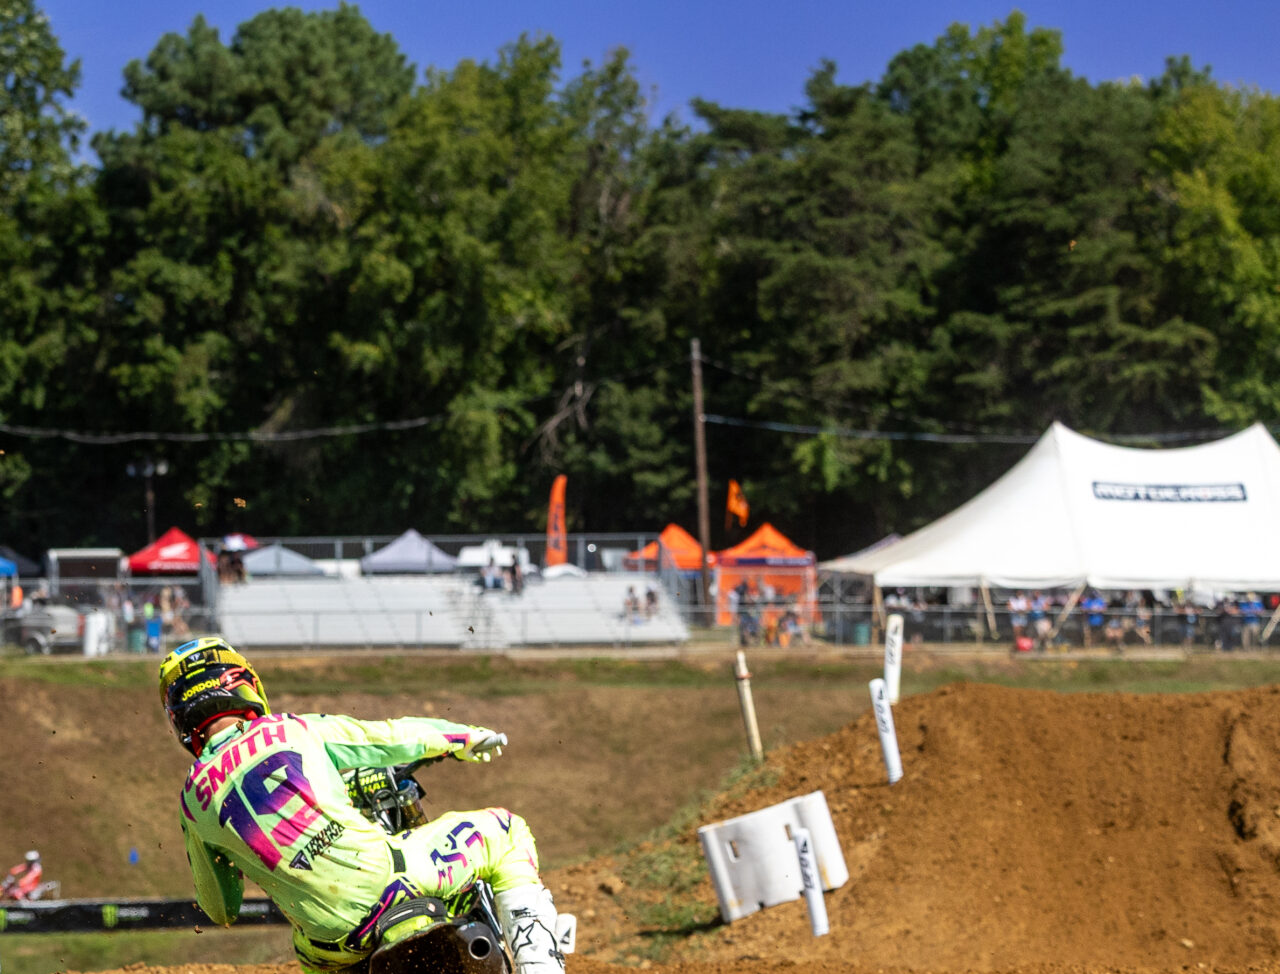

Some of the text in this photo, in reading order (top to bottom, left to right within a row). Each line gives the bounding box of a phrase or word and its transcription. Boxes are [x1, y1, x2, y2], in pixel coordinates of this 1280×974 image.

[181, 678, 221, 702] JORDON
[195, 724, 288, 812] SMITH
[219, 750, 324, 872] 19
[304, 820, 343, 854] TRIUMP
